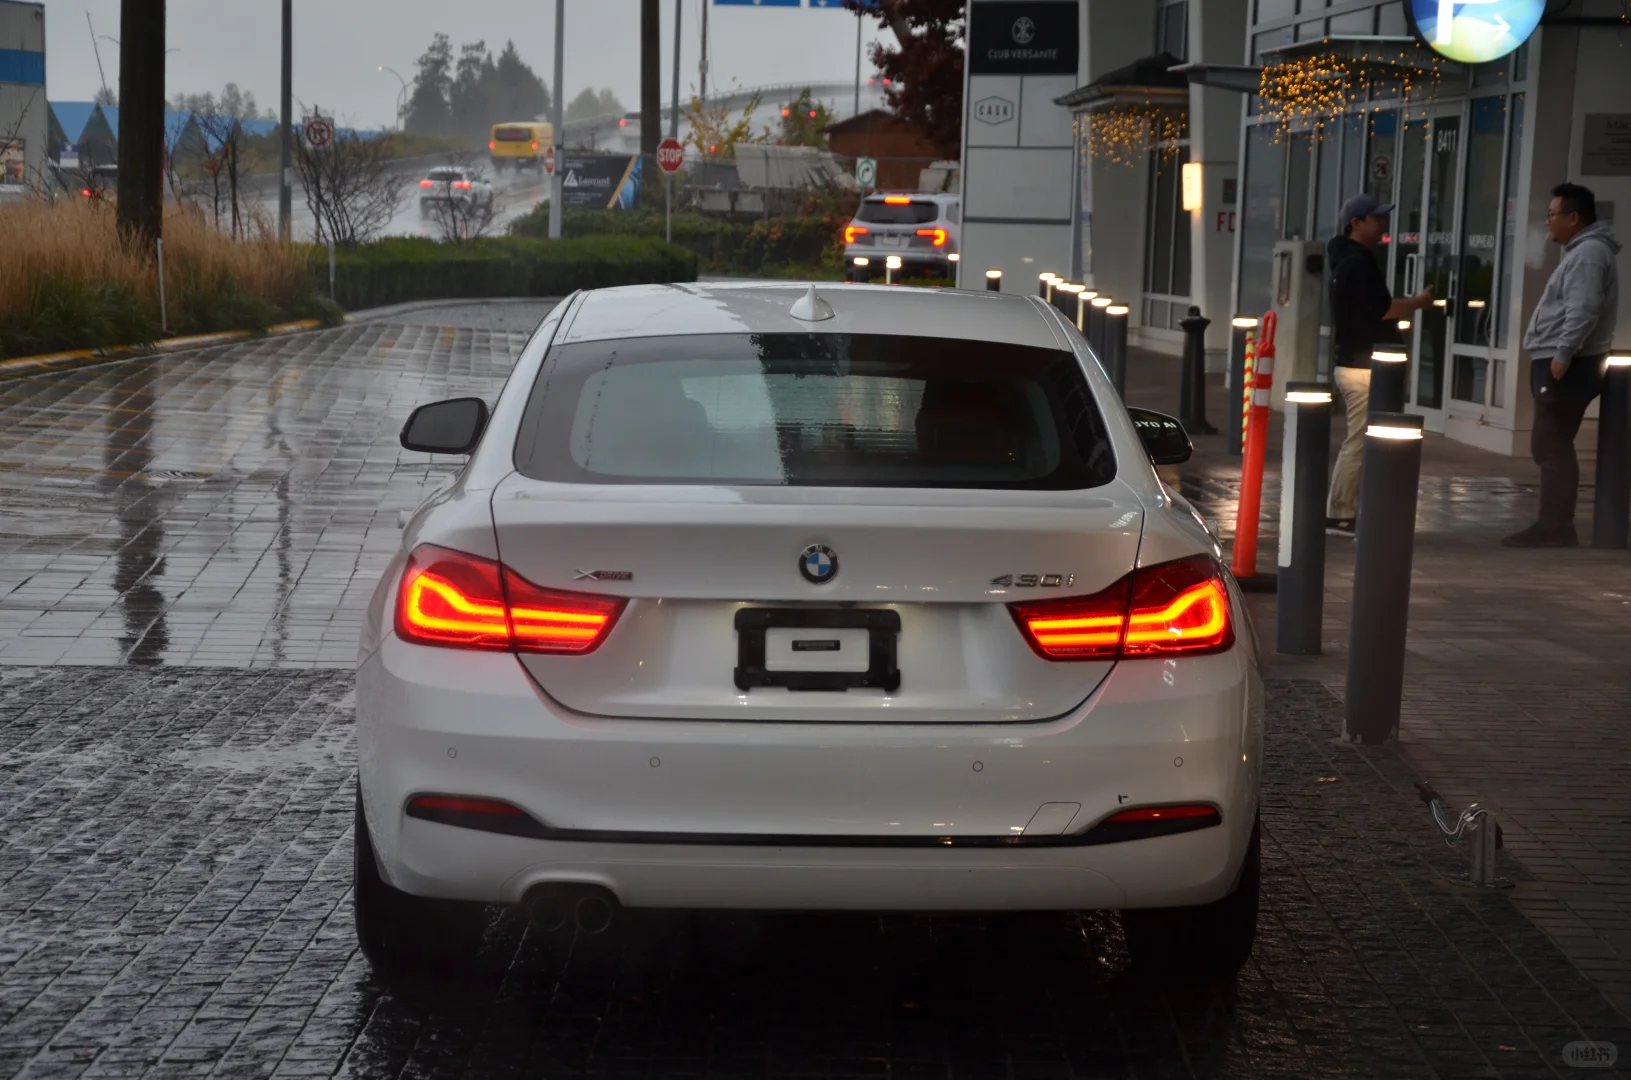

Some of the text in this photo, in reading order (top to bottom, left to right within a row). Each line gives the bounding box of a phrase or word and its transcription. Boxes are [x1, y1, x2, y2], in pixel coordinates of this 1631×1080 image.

[987, 48, 1058, 59] CLUB VERSANTE
[979, 105, 1008, 116] CASK
[1437, 129, 1456, 152] 8411
[659, 148, 682, 163] STOP
[990, 574, 1074, 588] 430i
